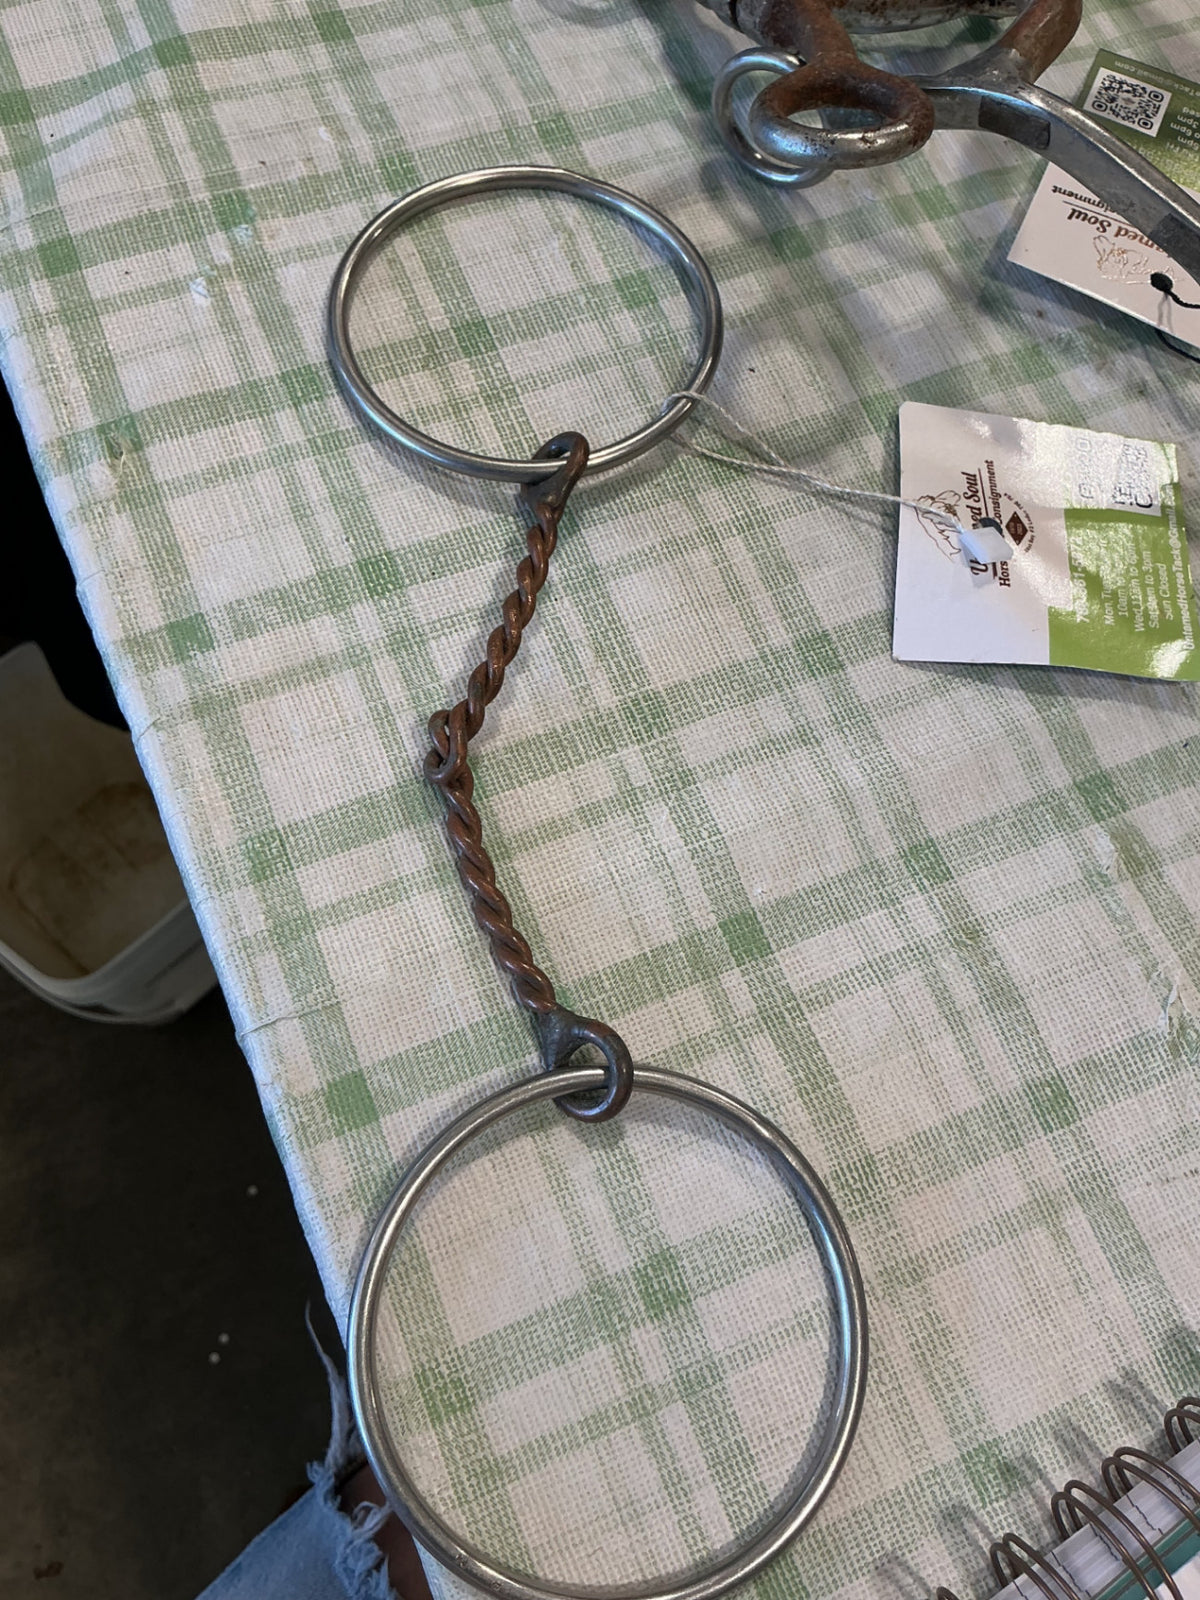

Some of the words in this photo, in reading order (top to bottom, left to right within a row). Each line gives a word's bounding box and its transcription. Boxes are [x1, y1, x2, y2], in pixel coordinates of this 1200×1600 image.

[1177, 115, 1199, 129] 3pm
[1067, 208, 1111, 233] Soul
[961, 471, 981, 503] Soul
[1129, 566, 1139, 577] to
[1142, 551, 1154, 573] 3pm
[999, 561, 1011, 588] Hors
[1145, 573, 1154, 585] to
[1155, 563, 1170, 598] Closed
[1162, 601, 1174, 621] Sun
